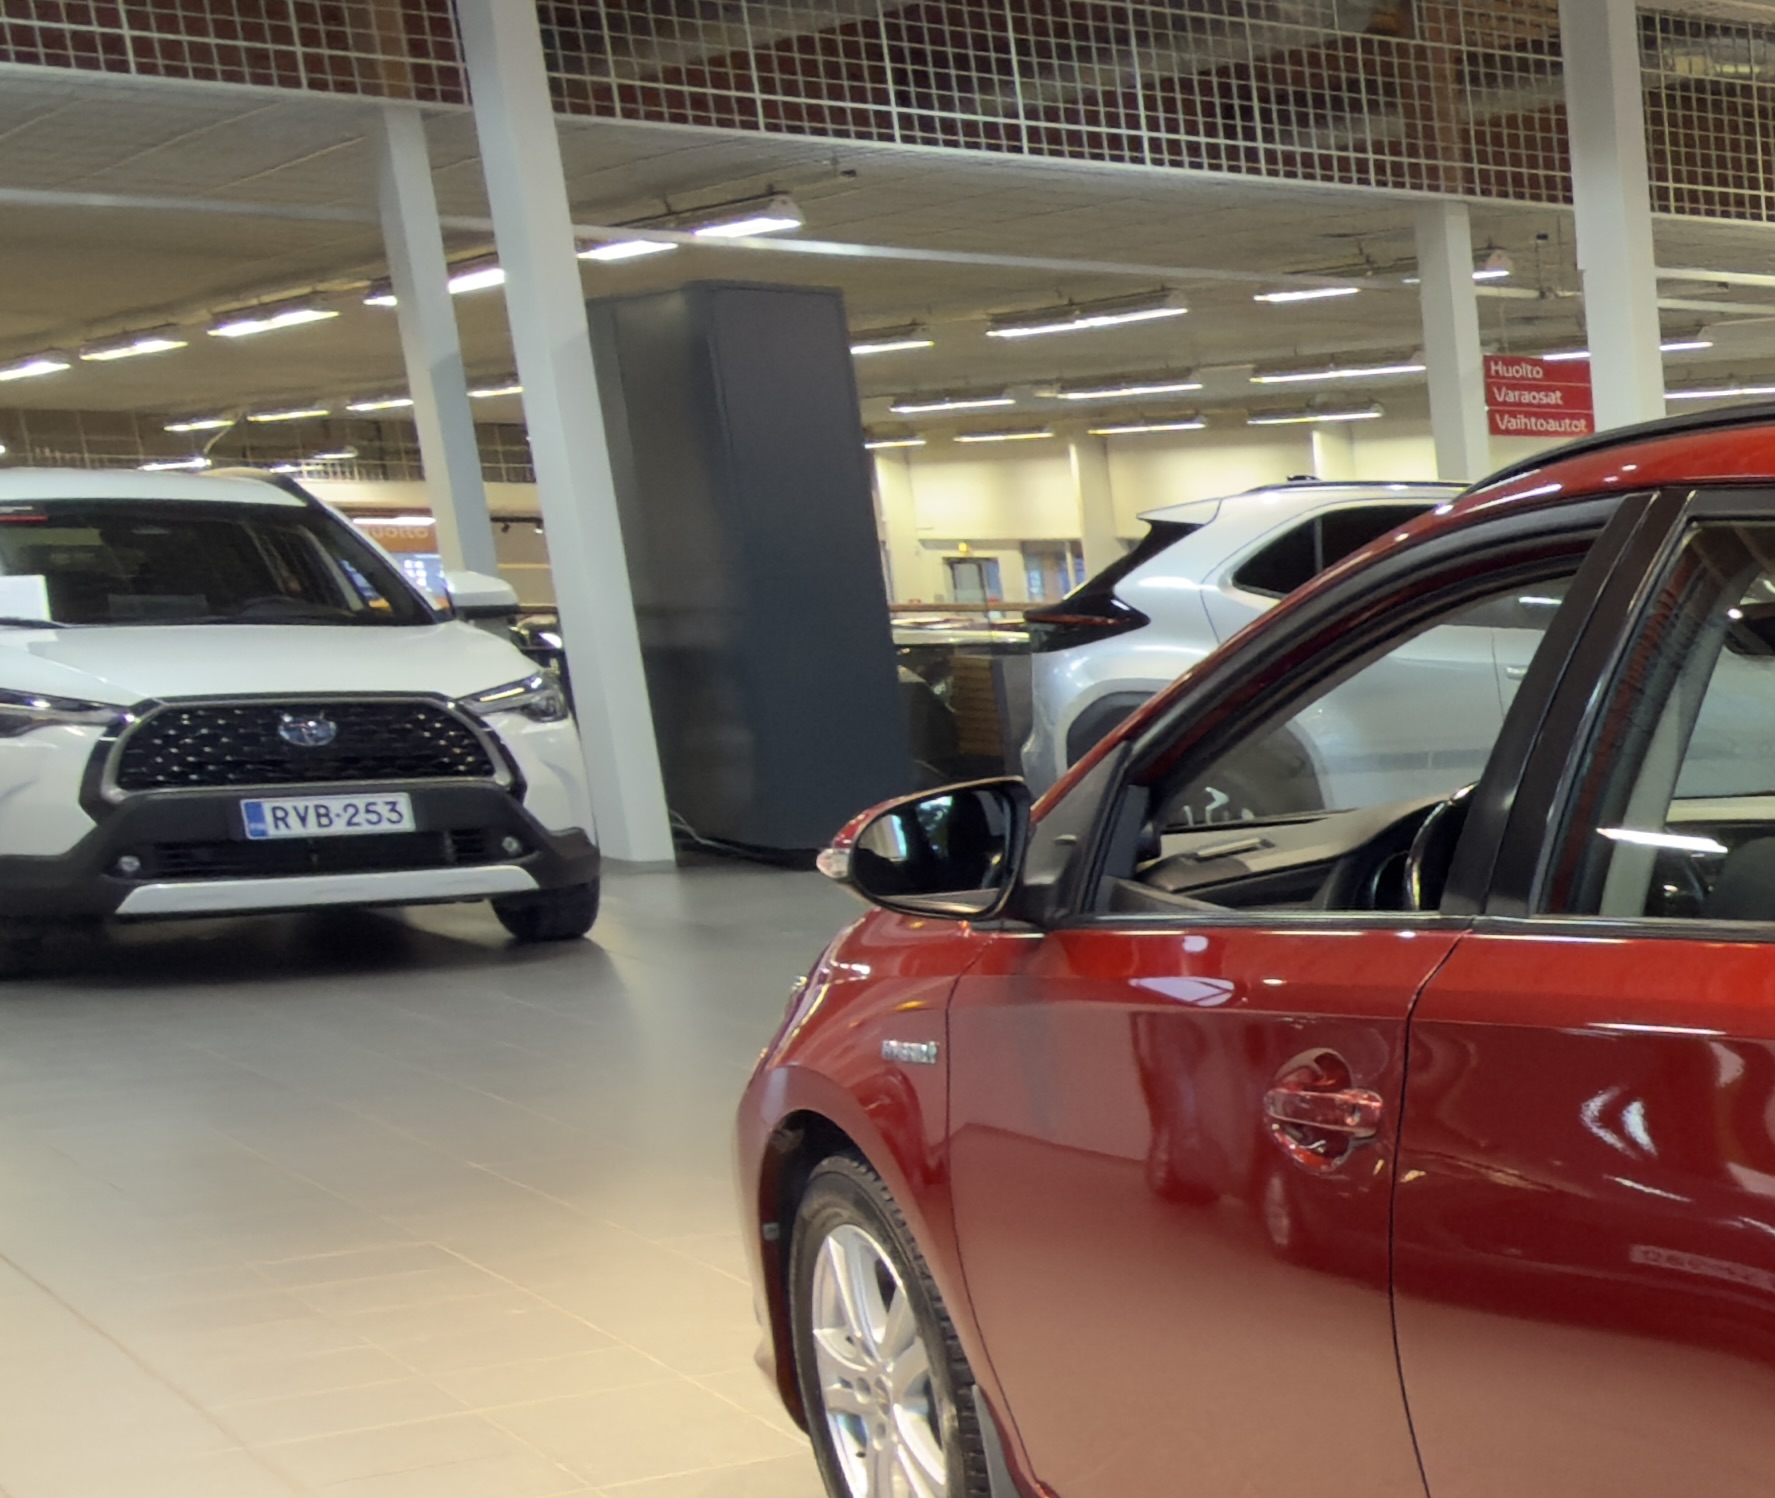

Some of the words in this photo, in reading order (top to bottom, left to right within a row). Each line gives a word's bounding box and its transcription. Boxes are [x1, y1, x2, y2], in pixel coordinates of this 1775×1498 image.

[1490, 361, 1543, 379] Huolto
[1493, 386, 1563, 405] Varaosat
[1495, 414, 1589, 432] Vaihtoautot
[271, 801, 404, 830] RVB-253
